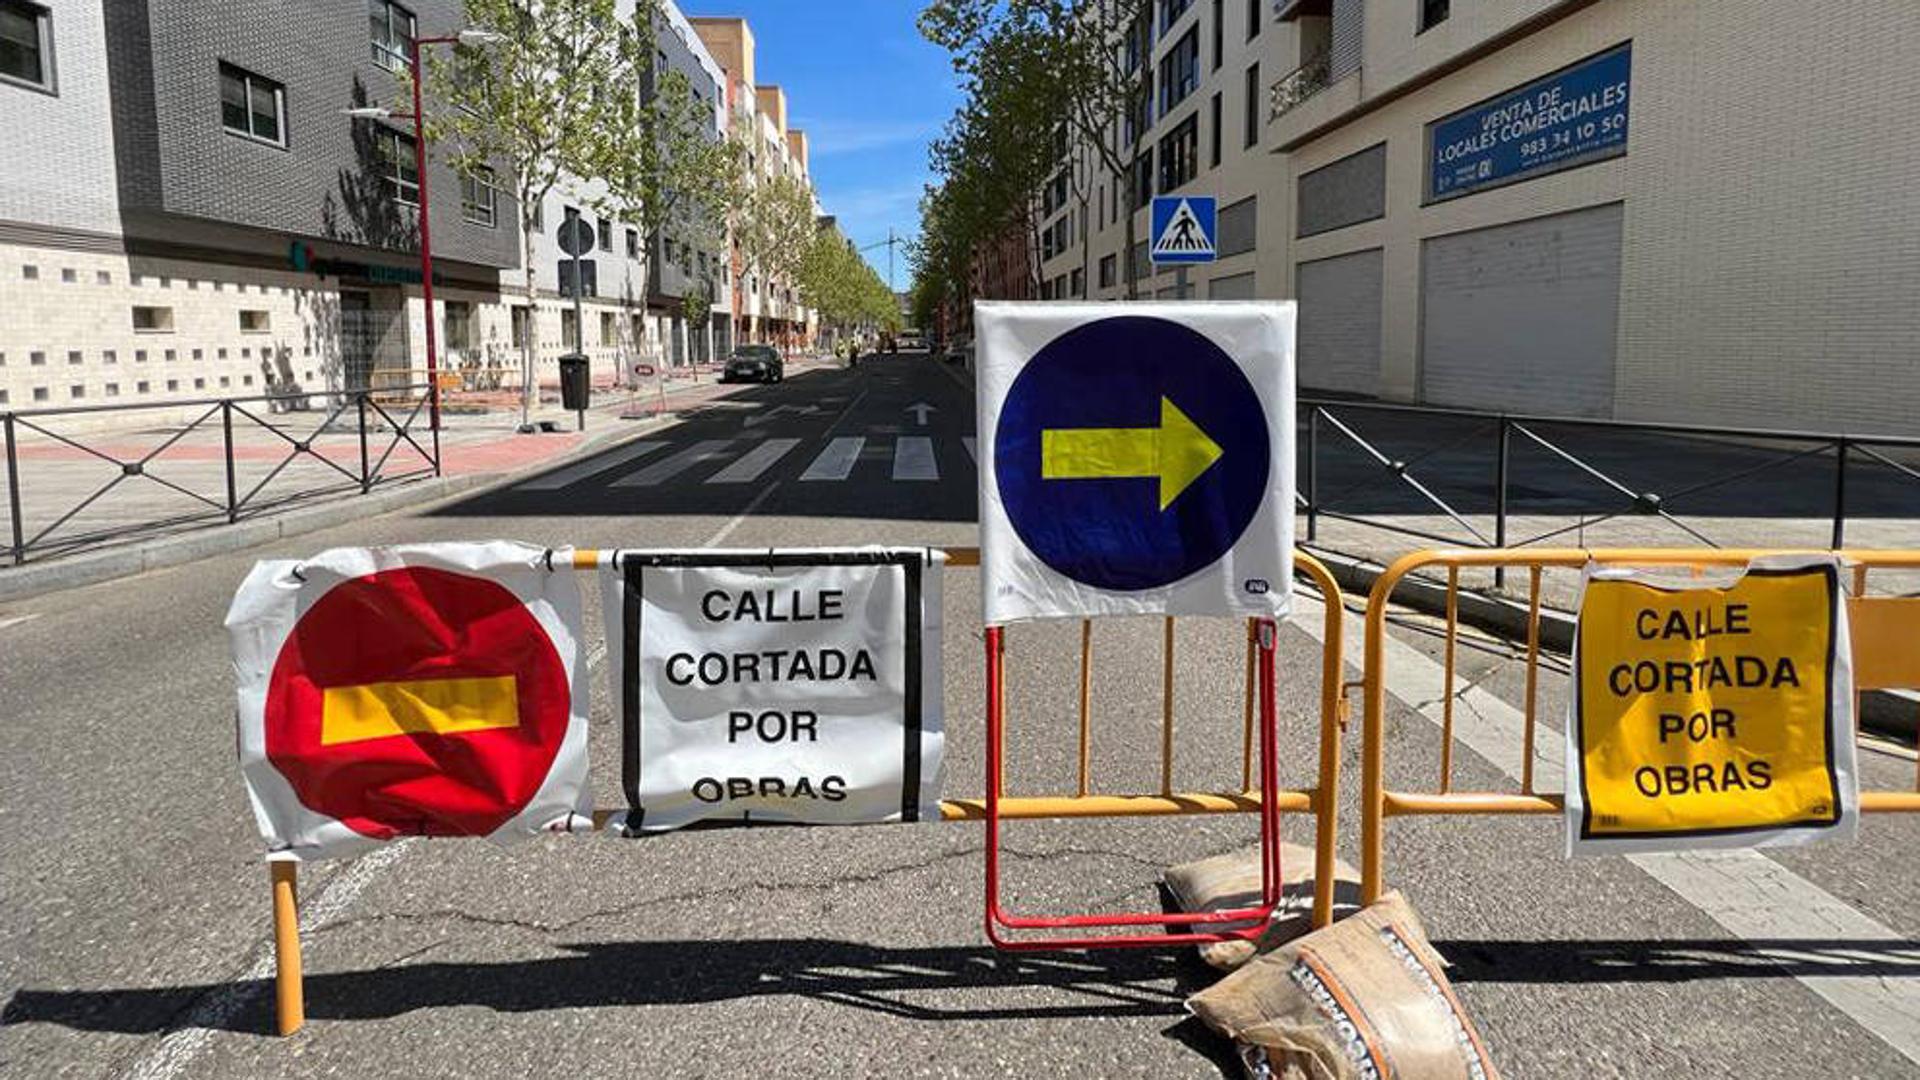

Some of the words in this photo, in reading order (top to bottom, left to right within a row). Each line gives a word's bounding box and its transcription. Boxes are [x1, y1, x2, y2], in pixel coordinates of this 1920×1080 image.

[1438, 130, 1498, 163] LOCALES
[1500, 82, 1628, 142] COMERCIALES
[1482, 99, 1533, 130] VENTA
[1538, 86, 1562, 110] DE
[1519, 137, 1547, 157] 983
[1576, 122, 1596, 142] 10
[1601, 113, 1626, 133] 50
[701, 589, 844, 622] CALLE
[1636, 603, 1752, 641] CALLE
[665, 649, 877, 686] CORTADA
[1609, 656, 1800, 698] CORTADA
[728, 710, 818, 743] POR
[1658, 708, 1737, 744] POR
[692, 775, 848, 804] OBRAS
[1634, 760, 1772, 798] OBRAS
